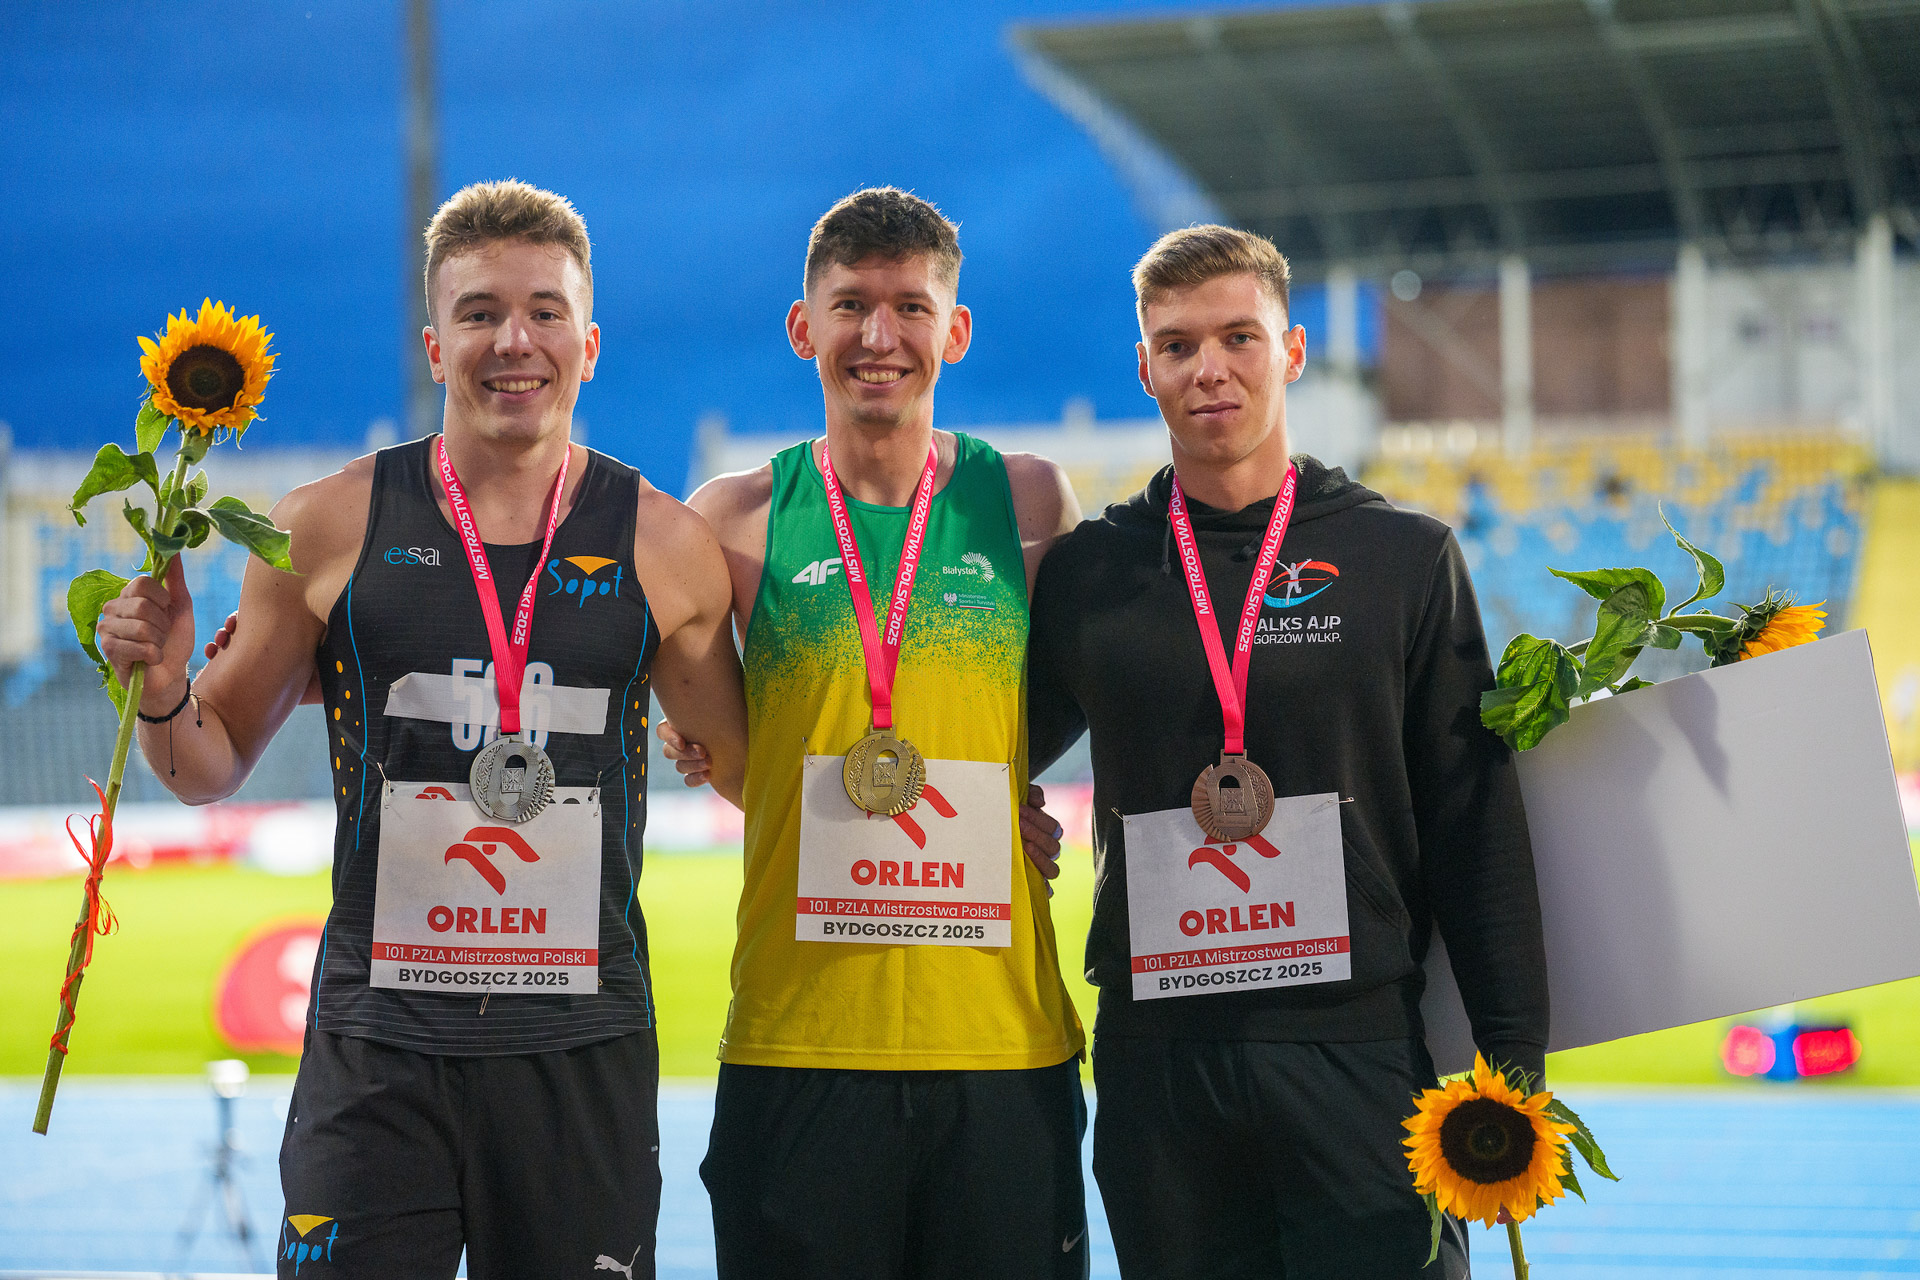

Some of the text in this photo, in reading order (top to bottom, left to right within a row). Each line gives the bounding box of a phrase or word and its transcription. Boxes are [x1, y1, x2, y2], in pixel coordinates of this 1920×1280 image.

[449, 482, 490, 580] MISTRZOSTWA
[830, 490, 862, 582] MISTRZOSTWA
[791, 557, 843, 586] 4F
[887, 467, 934, 647] MISTRZOSTWA POLSKI 2025
[1176, 516, 1210, 615] MISTRZOSTWA
[1238, 474, 1295, 652] MISTRZOSTWA POLSKI 2025
[547, 558, 624, 609] Sopot
[514, 610, 529, 646] 2025
[1253, 631, 1342, 645] GORZÓW WLKP.
[1256, 615, 1342, 633] ALKS AJP
[850, 859, 965, 889] ORLEN
[427, 905, 547, 934] ORLEN
[809, 900, 1000, 918] 101. PZLA Mistrzostwa Polski
[1178, 901, 1296, 937] ORLEN
[823, 921, 985, 939] BYDGOSZCZ 2025
[385, 945, 586, 964] 101. PZLA Mistrzostwa Polski
[1143, 939, 1338, 970] 101. PZLA Mistrzostwa Polski
[398, 968, 570, 986] BYDGOSZCZ 2025
[1158, 961, 1323, 991] BYDGOSZCZ 2025
[279, 1218, 339, 1277] Sopot
